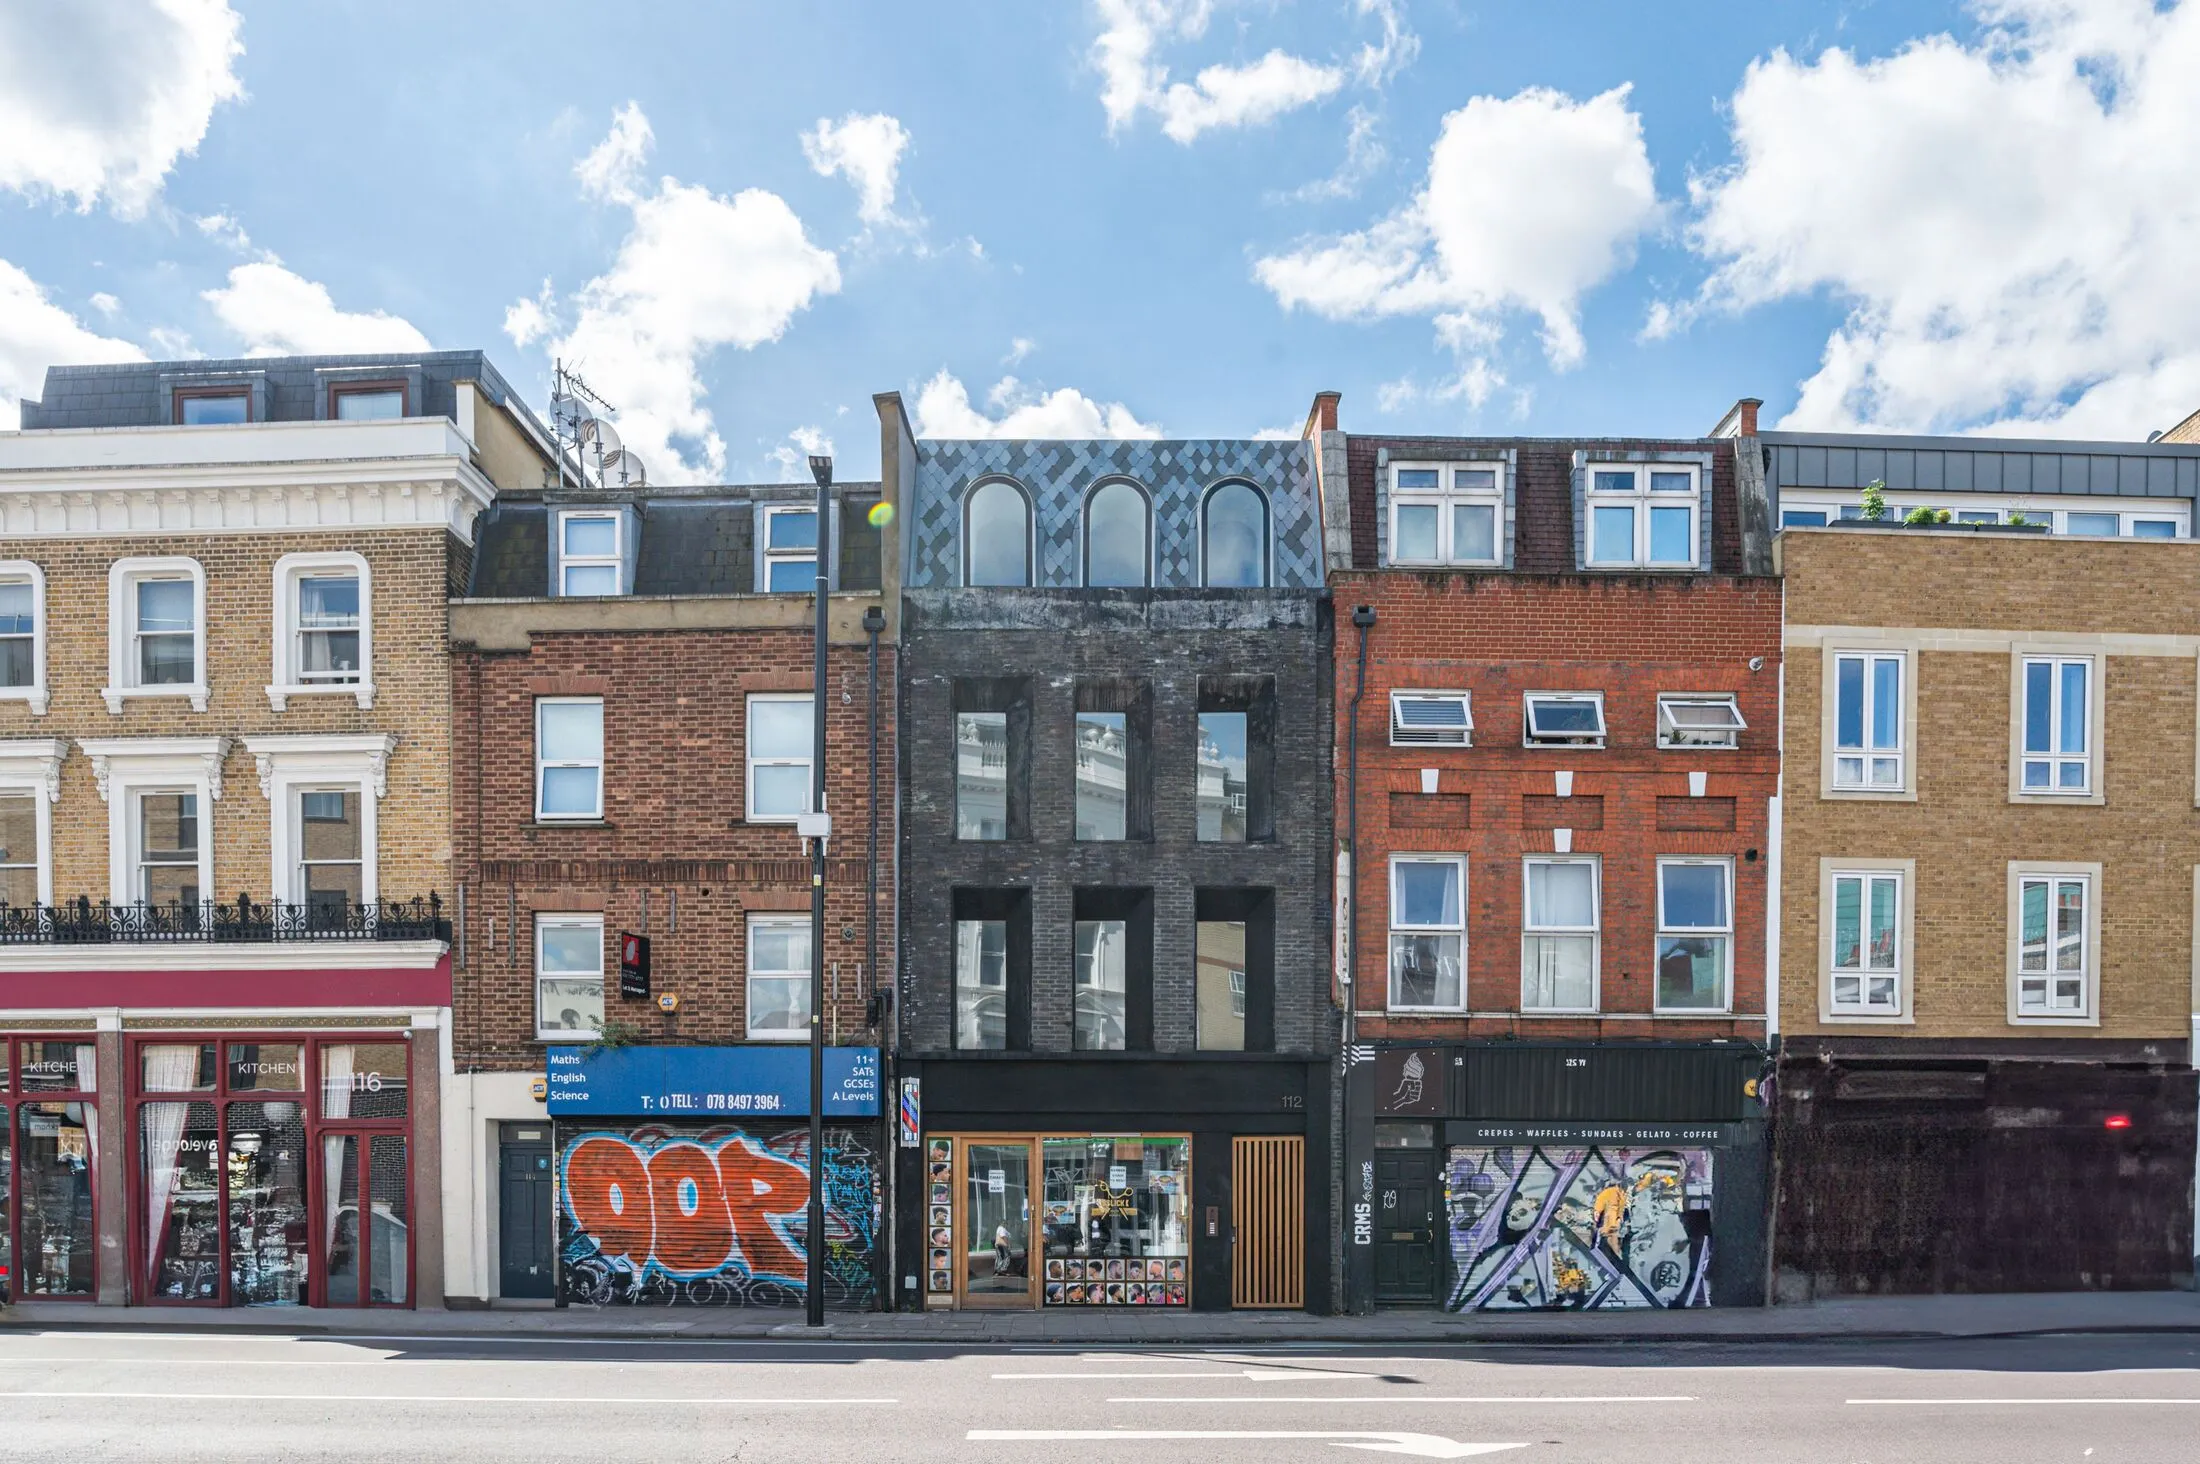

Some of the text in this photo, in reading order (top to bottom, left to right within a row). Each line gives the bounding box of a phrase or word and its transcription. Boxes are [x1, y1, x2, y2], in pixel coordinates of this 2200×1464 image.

[550, 1055, 580, 1064] Maths
[856, 1055, 874, 1064] 11+
[29, 1061, 77, 1073] KITCHE
[238, 1063, 296, 1074] KITCHEN
[852, 1067, 874, 1076] SATs
[350, 1071, 382, 1092] 116
[551, 1073, 586, 1084] English
[843, 1079, 874, 1088] GCSEs
[551, 1091, 589, 1100] Science
[832, 1091, 874, 1101] A Levels
[706, 1094, 725, 1109] 078
[727, 1094, 752, 1109] 8497
[754, 1095, 779, 1109] 3964
[1281, 1095, 1303, 1108] 112
[1478, 1129, 1719, 1139] CREPES WAFFLES SUNDAES GELATO COFFEE
[1354, 1203, 1371, 1245] CRMS
